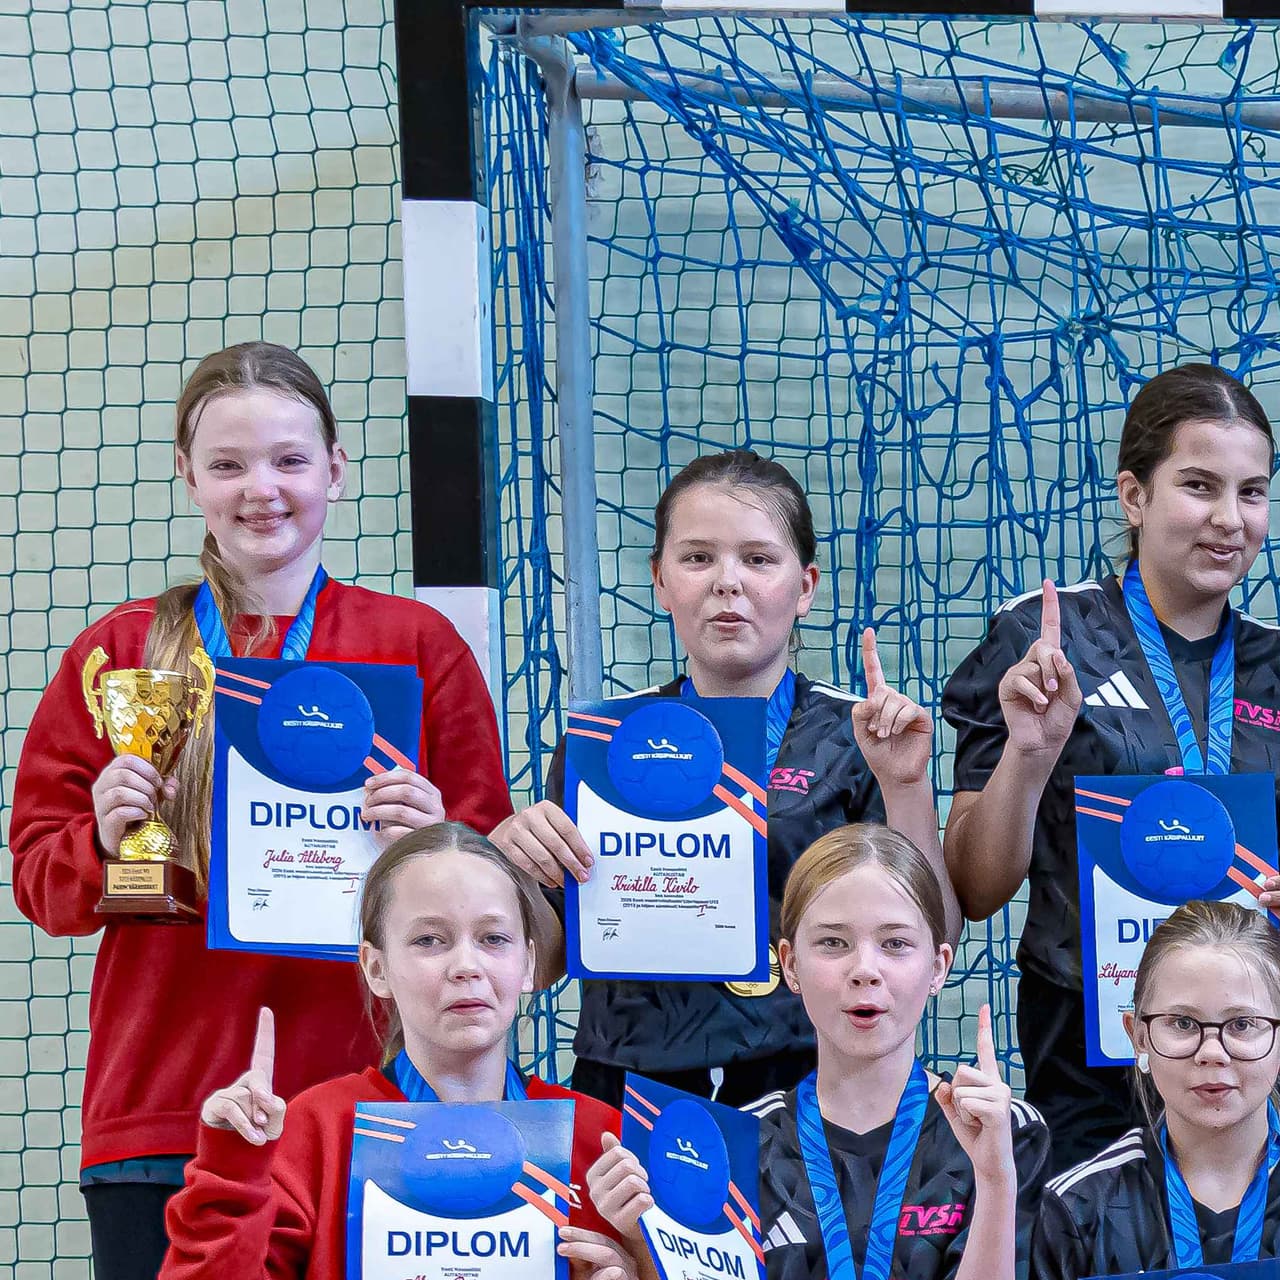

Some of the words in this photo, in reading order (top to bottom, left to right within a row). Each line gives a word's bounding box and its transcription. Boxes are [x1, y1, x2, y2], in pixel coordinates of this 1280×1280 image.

[250, 801, 381, 832] DIPLOM
[600, 832, 731, 859] DIPLOM
[263, 850, 295, 869] Julia
[610, 874, 658, 892] Kristella
[661, 877, 700, 894] Kivilo
[387, 1231, 530, 1257] DIPLOM
[657, 1227, 746, 1280] DIPLOM
